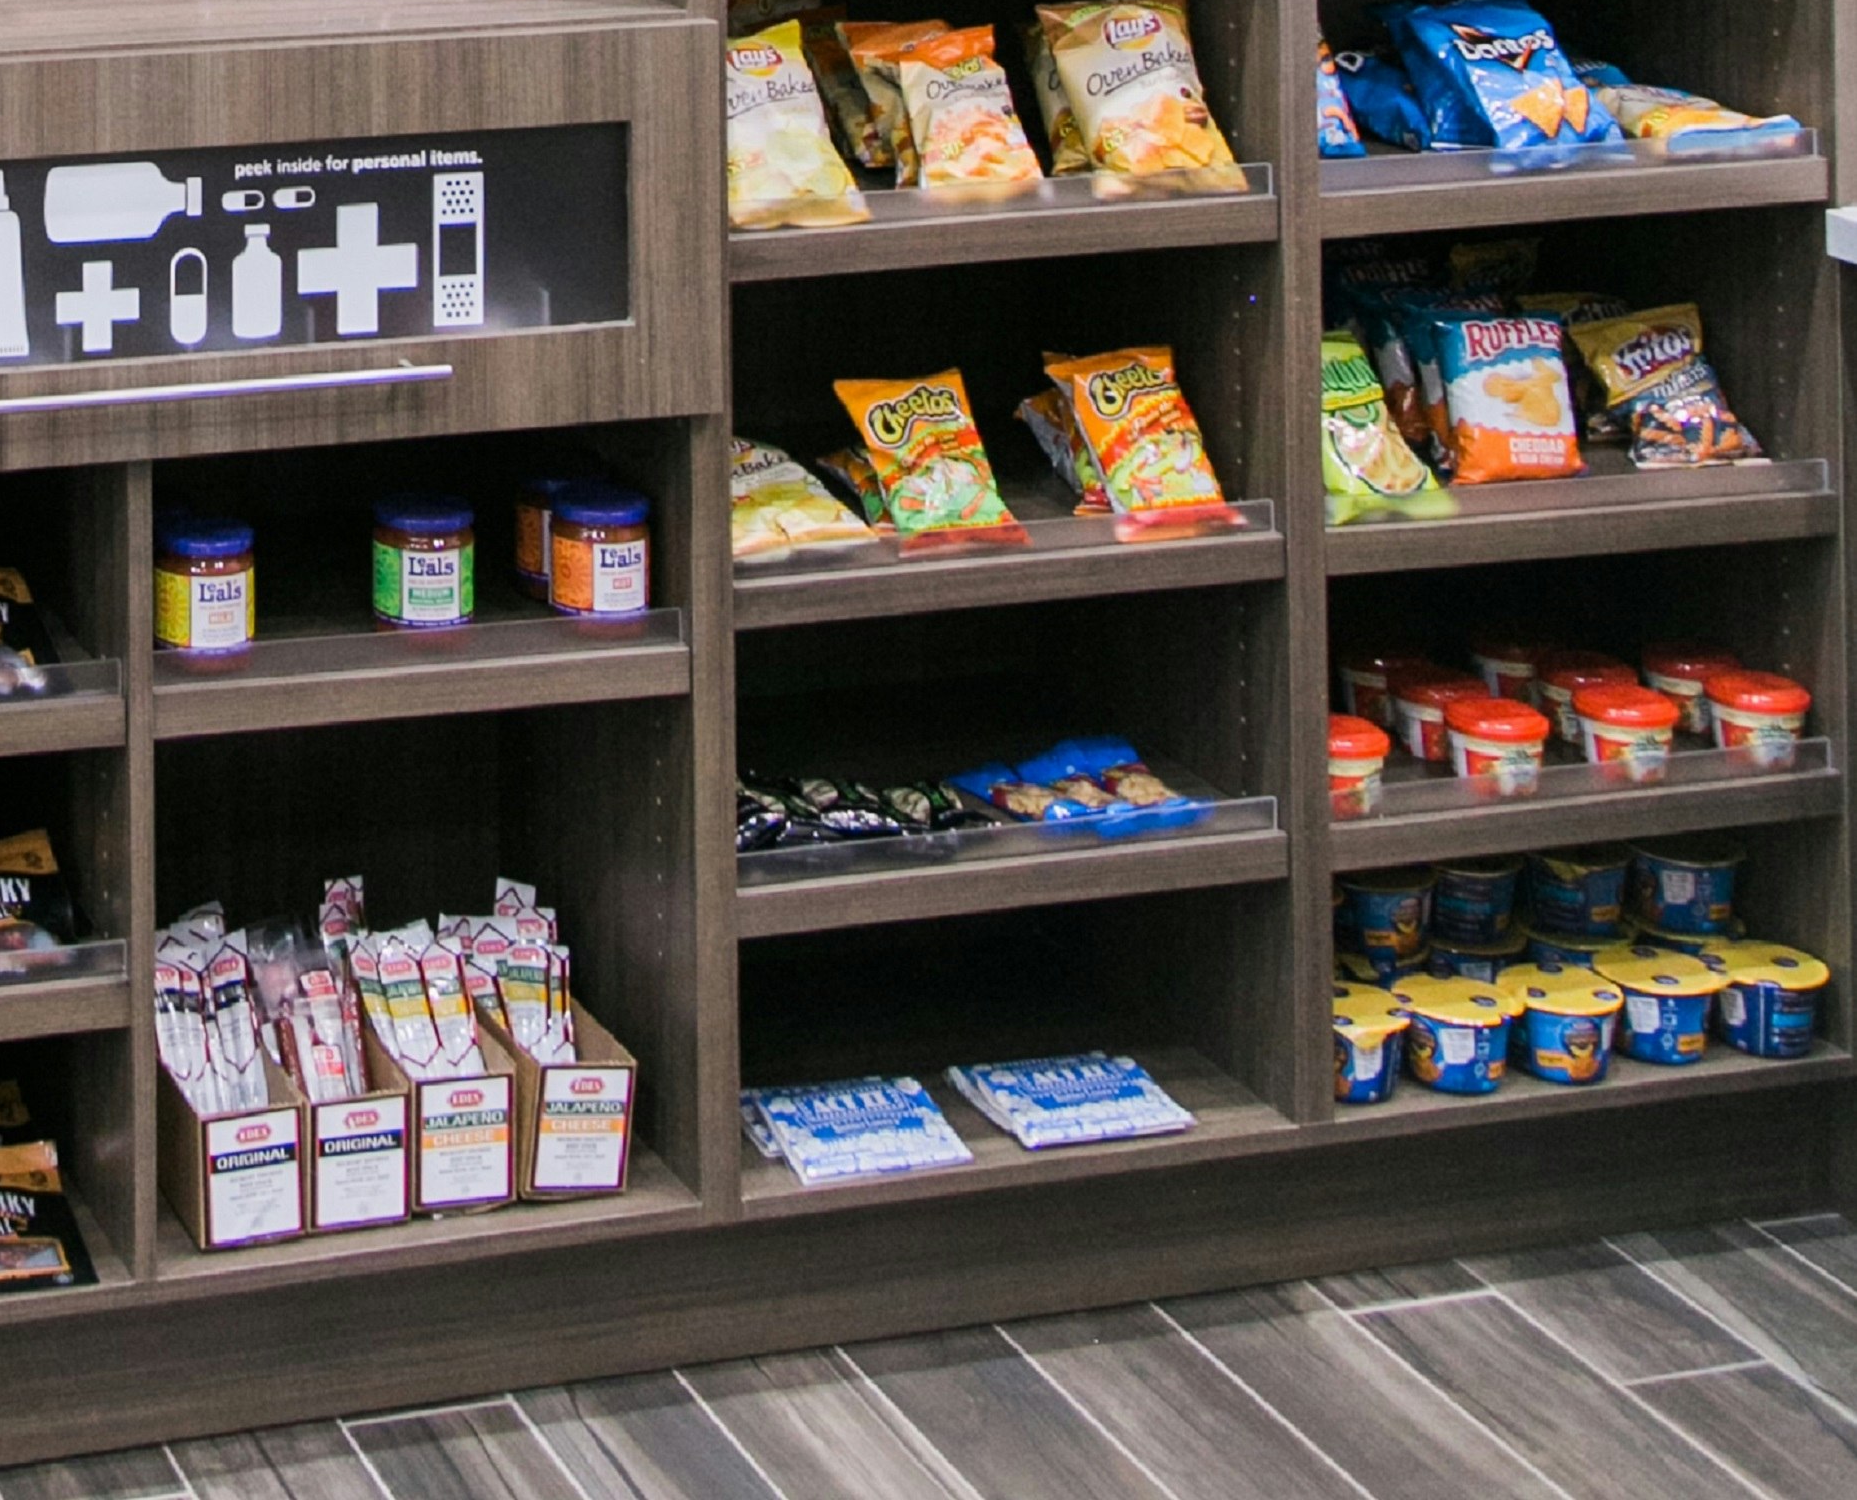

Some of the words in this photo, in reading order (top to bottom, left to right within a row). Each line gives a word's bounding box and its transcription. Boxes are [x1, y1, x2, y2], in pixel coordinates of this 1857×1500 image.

[1454, 28, 1555, 61] Doritos
[1086, 62, 1140, 97] Oven
[235, 158, 272, 180] peek
[277, 157, 322, 175] inside
[326, 154, 350, 171] for
[352, 150, 427, 175] personal
[430, 149, 483, 166] items.
[1464, 320, 1563, 361] RUFFLES
[216, 1147, 289, 1170] ORIGINAL
[325, 1133, 397, 1154] ORIGINAL
